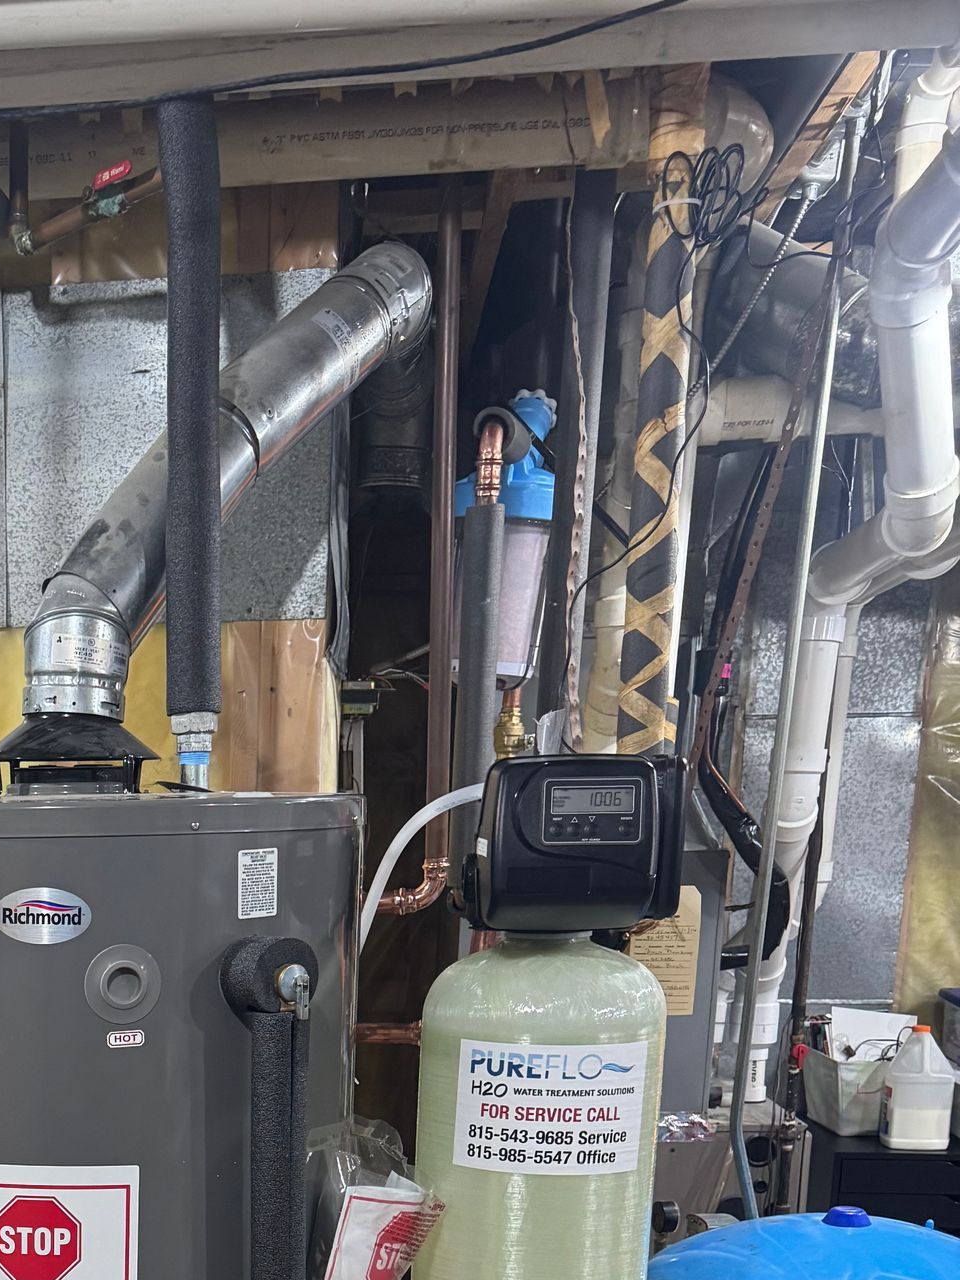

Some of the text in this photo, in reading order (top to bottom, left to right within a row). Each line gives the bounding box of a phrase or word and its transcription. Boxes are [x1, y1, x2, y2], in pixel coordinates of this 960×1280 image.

[2, 907, 82, 925] Richmond
[114, 1034, 138, 1043] HOT
[470, 1049, 602, 1080] PUREFLO
[471, 1080, 635, 1098] H2O WATER TREATMENT SOLUTIONS
[481, 1103, 620, 1123] FOR SERVICE CALL
[469, 1124, 627, 1145] 815-543-9685 Service
[468, 1143, 616, 1165] 815-985-5547 Office
[0, 1225, 71, 1256] STOP
